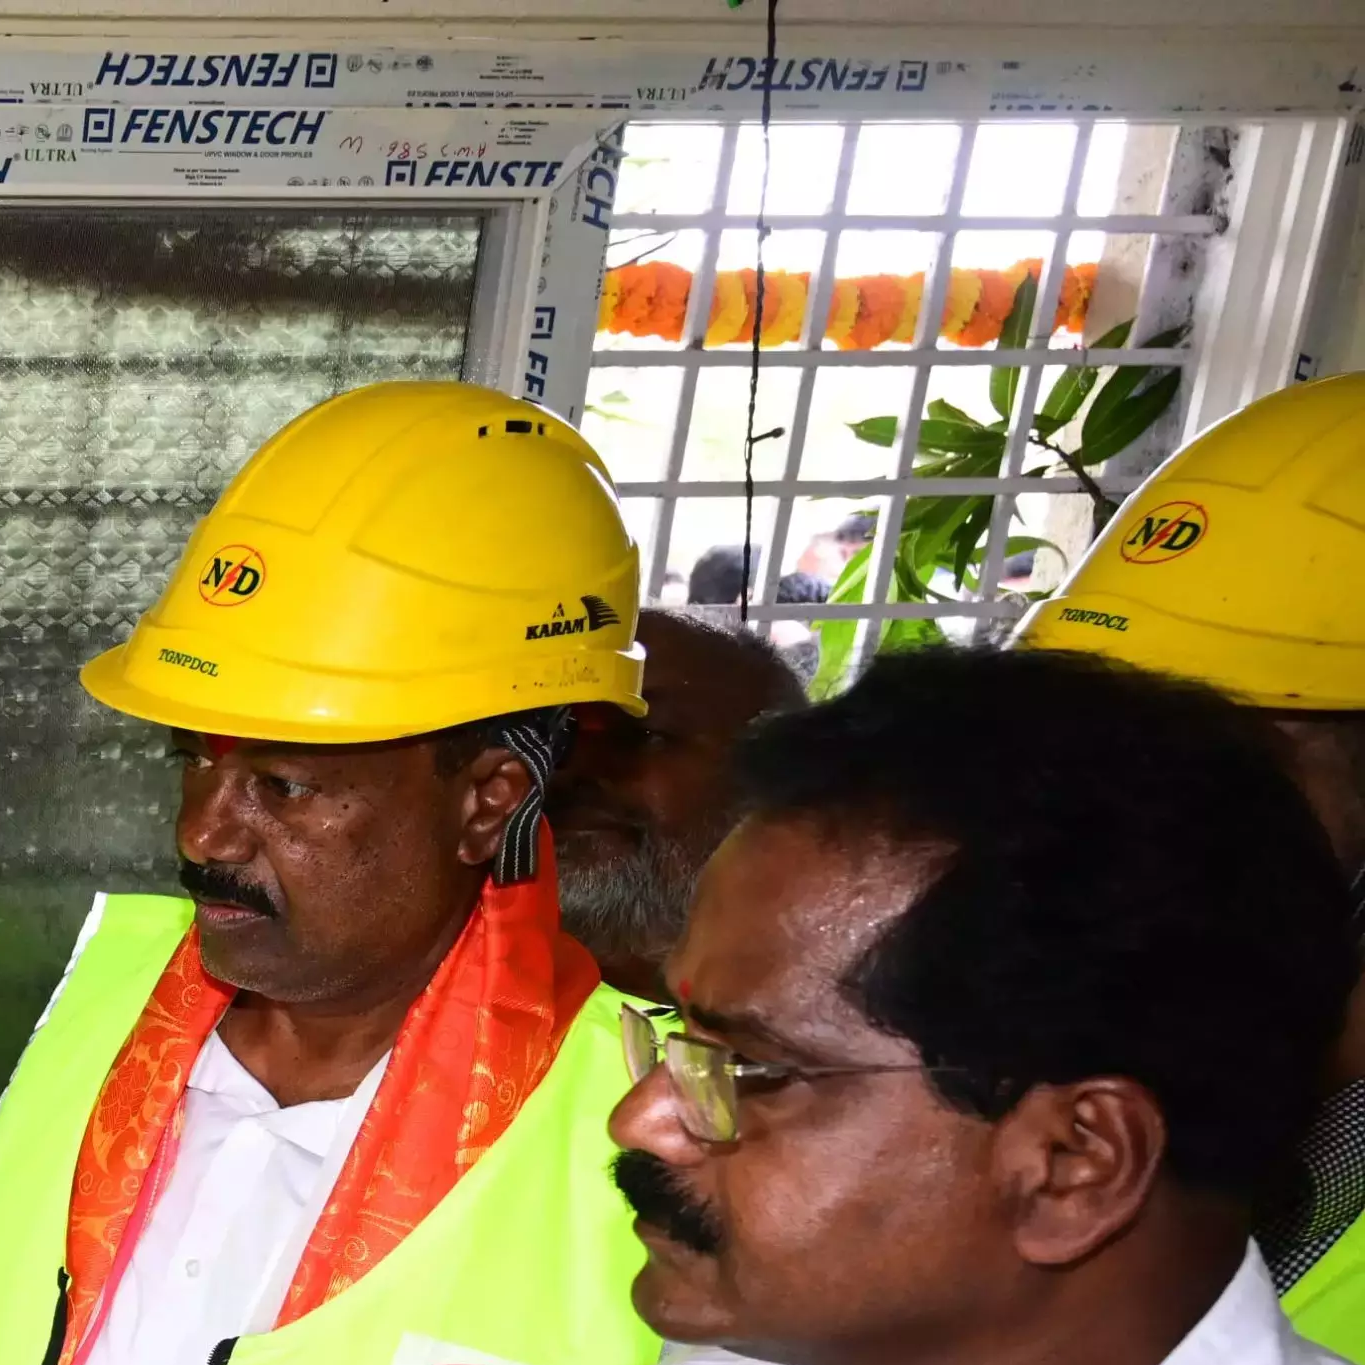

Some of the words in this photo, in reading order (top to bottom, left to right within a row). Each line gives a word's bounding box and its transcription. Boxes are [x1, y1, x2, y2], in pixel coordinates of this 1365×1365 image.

[95, 52, 300, 87] FENSTECH
[121, 110, 325, 145] FENSTECH
[24, 149, 78, 162] ULTRA
[525, 617, 586, 640] KARAM
[1058, 608, 1130, 632] TGNPDCL
[158, 648, 219, 677] TGNPDCL
